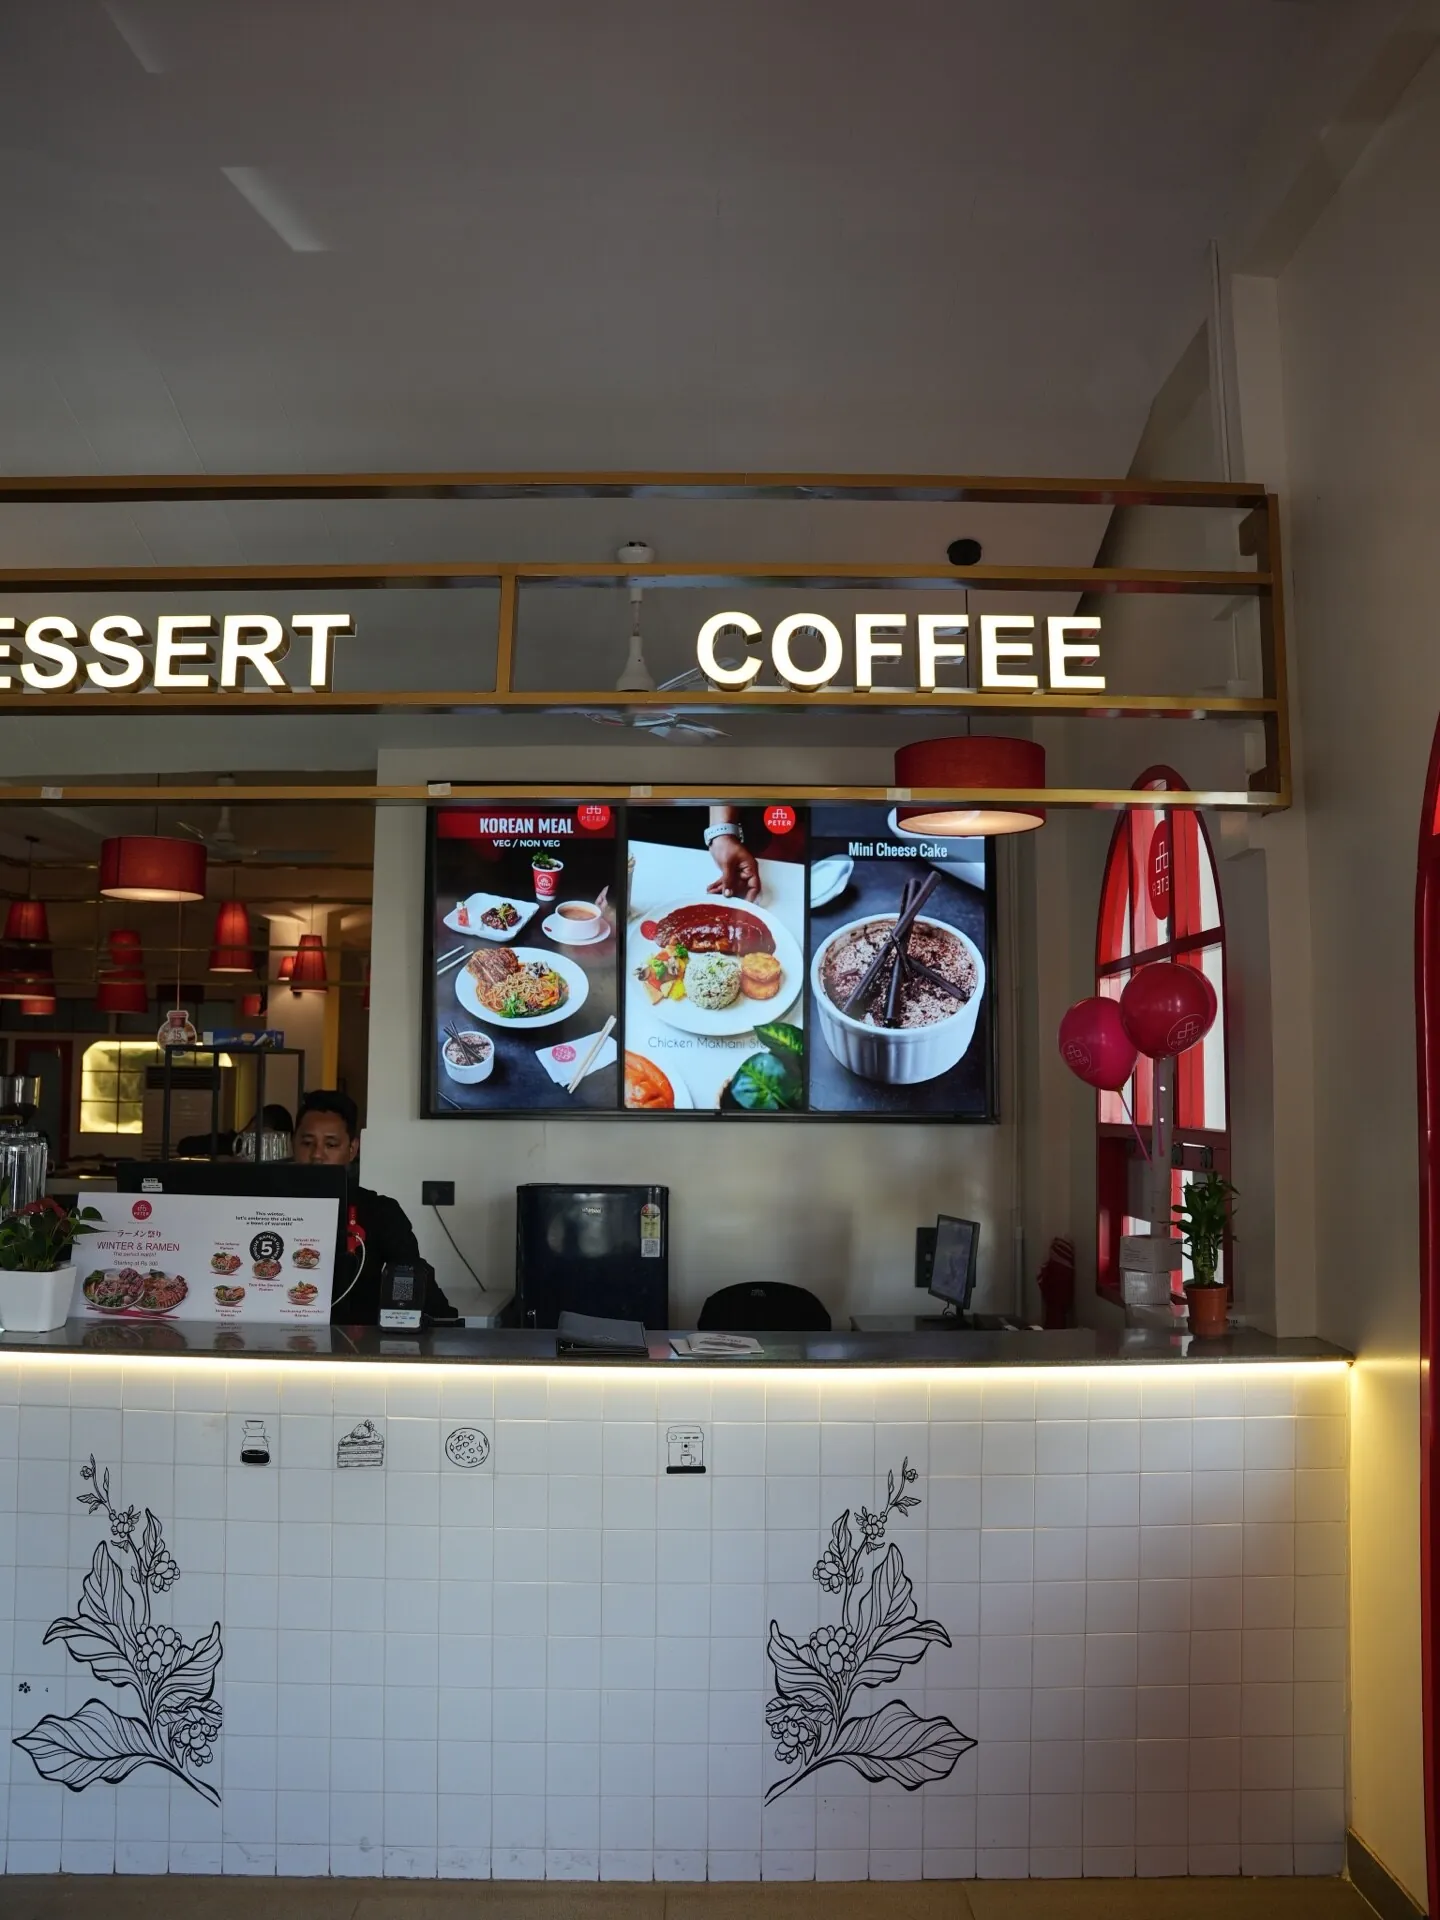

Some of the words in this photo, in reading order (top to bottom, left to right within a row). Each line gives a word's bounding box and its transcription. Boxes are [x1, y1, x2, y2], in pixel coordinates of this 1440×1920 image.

[0, 613, 355, 692] SSERT
[697, 611, 1106, 691] COFFEE
[479, 817, 534, 834] KOREAN
[538, 817, 574, 834] MEAL
[767, 819, 792, 827] PETER
[492, 839, 511, 847] VEG
[512, 838, 519, 849] /
[519, 839, 541, 847] NON
[542, 839, 561, 848] VEG
[848, 841, 874, 857] Mini
[876, 842, 917, 857] Cheese
[919, 843, 948, 858] Cake
[647, 1036, 693, 1048] Chicken
[697, 1037, 746, 1049] Makhani
[97, 1241, 134, 1251] WINTER
[136, 1242, 143, 1251] &
[145, 1242, 180, 1252] RAMEN
[260, 1240, 274, 1256] 5
